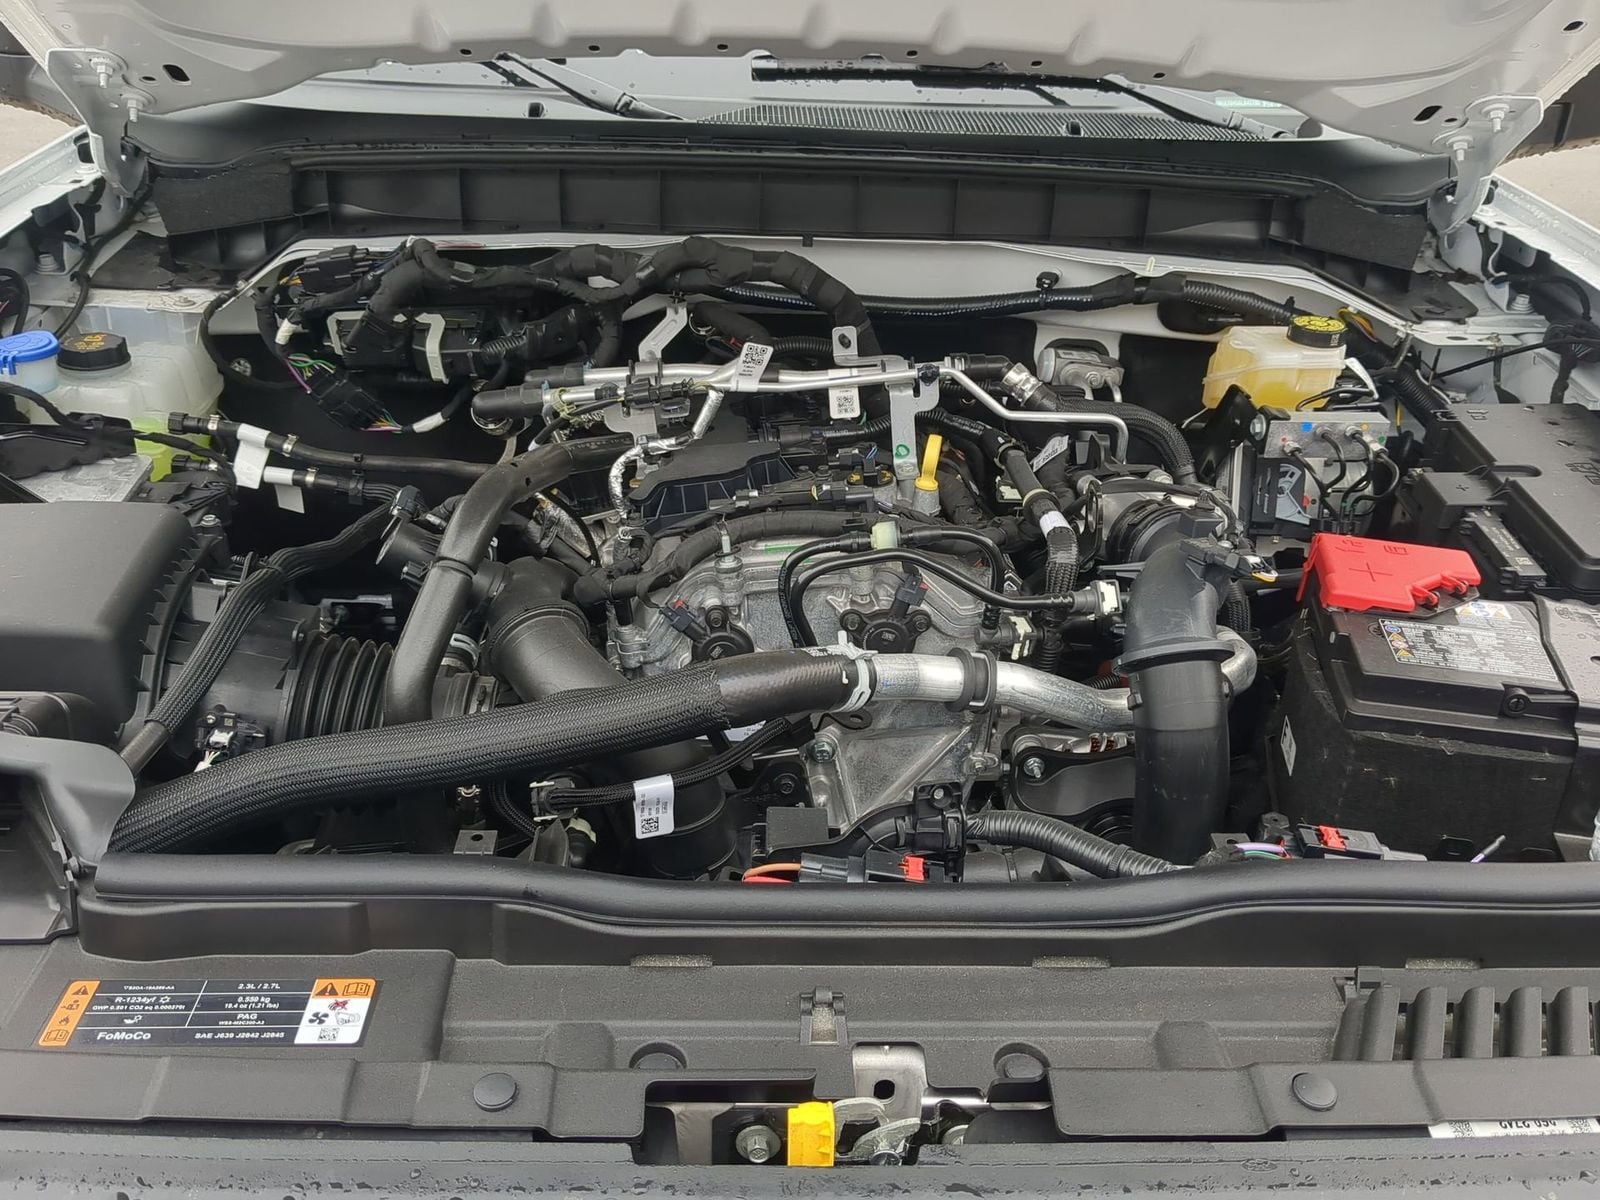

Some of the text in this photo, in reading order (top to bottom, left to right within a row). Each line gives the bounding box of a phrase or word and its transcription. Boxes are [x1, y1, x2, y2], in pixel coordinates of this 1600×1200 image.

[115, 996, 157, 1004] R-1234yf
[260, 996, 271, 1004] kg
[97, 1031, 152, 1040] FoMoCo
